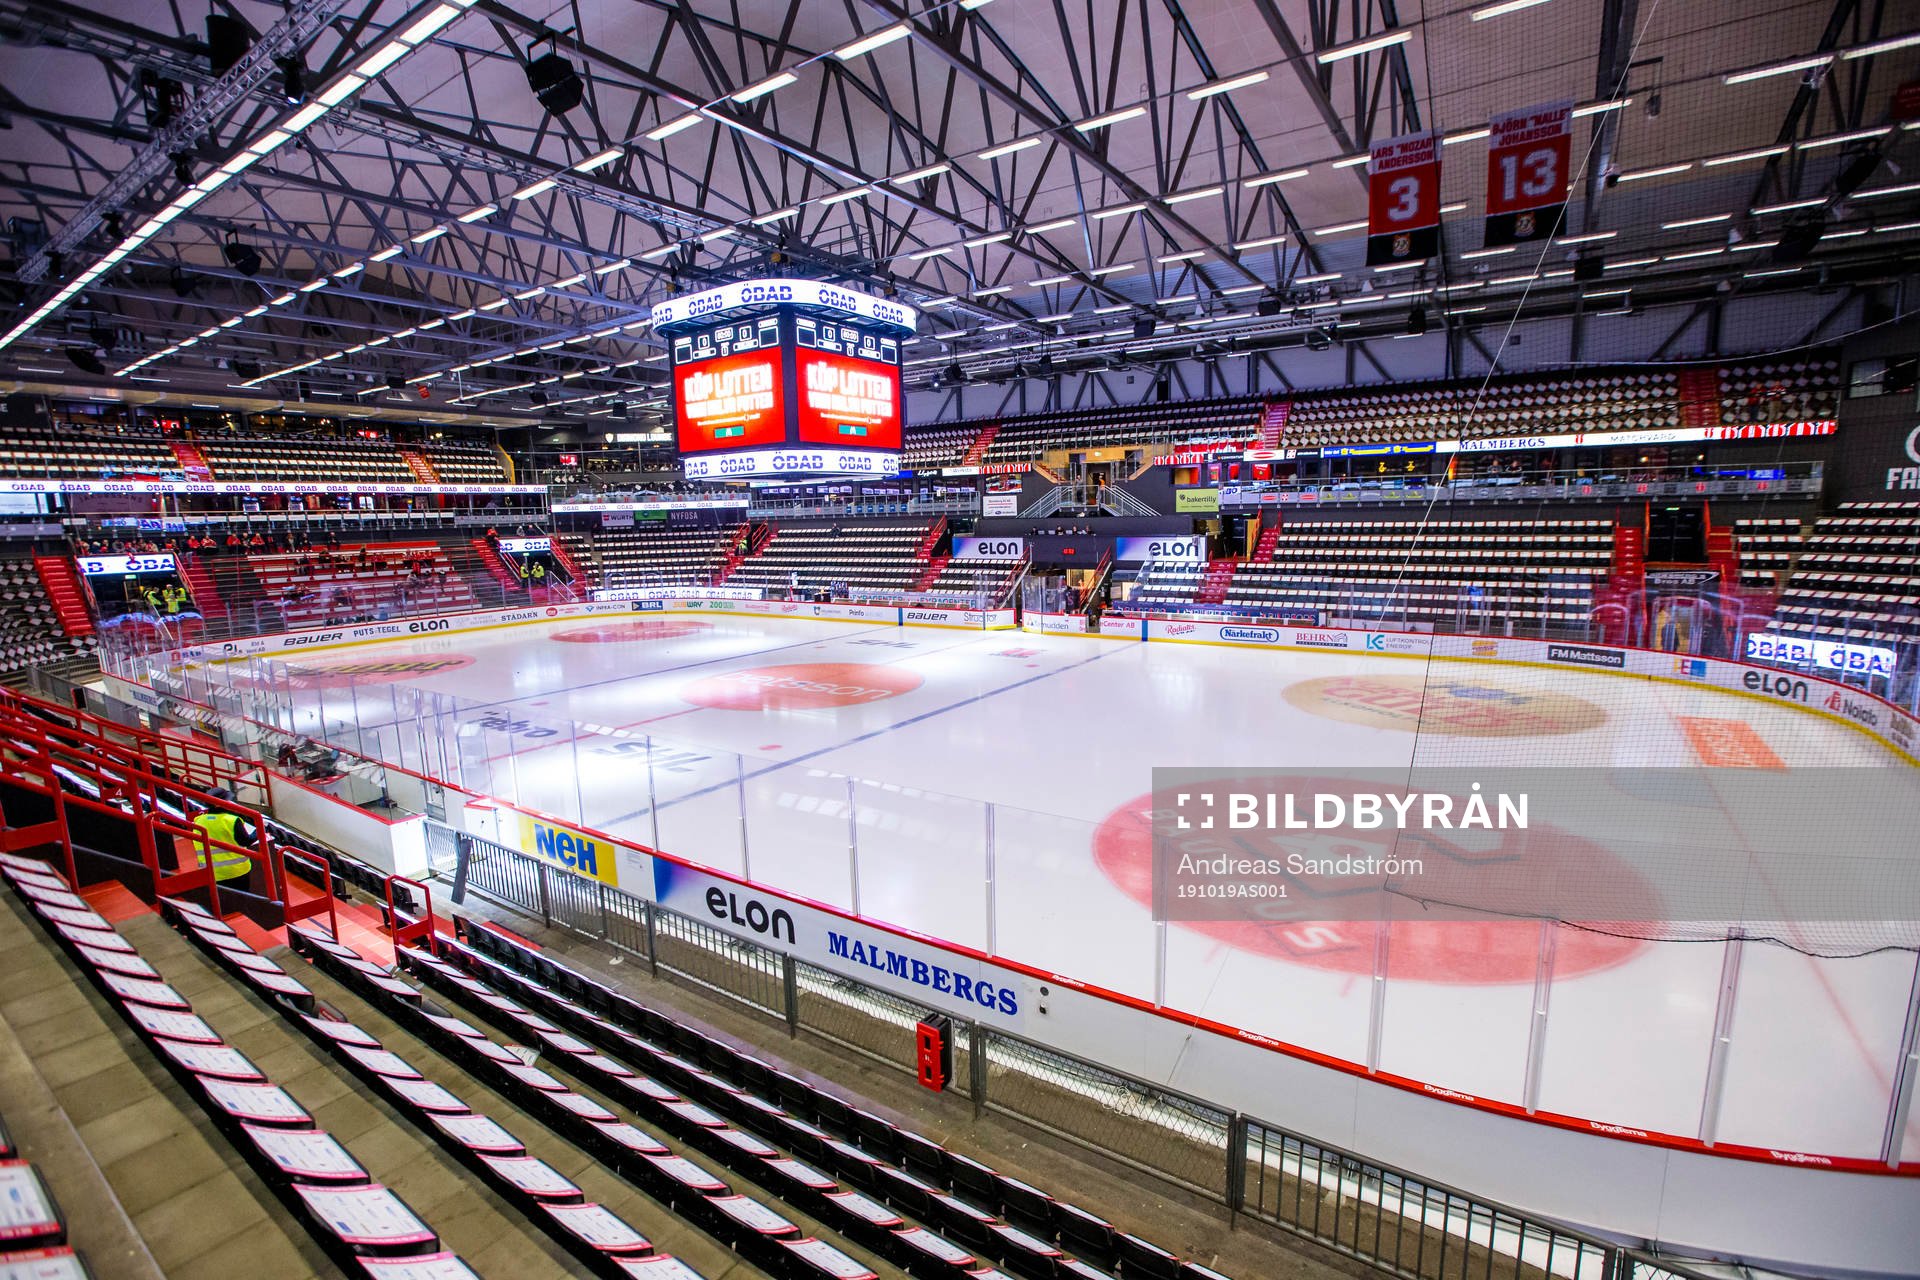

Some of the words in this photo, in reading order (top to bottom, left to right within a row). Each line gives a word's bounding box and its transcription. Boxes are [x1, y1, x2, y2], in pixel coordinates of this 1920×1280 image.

[1372, 145, 1394, 160] LARS
[1378, 150, 1434, 170] ANDERSSON
[1500, 149, 1558, 201] 13
[1387, 175, 1420, 222] 3
[714, 362, 773, 399] LOTTEN
[840, 367, 893, 401] LOTTEN
[1459, 437, 1546, 451] MALMBERGS
[1187, 495, 1217, 504] bakertilly
[671, 511, 698, 520] NYFOSA
[642, 601, 662, 609] BRL
[353, 627, 374, 638] PUTS
[377, 624, 402, 634] TEGEL
[1126, 621, 1135, 629] AB
[1296, 632, 1334, 643] BEHRN
[1551, 648, 1569, 659] FM
[1570, 650, 1622, 665] Mattsson
[828, 931, 1018, 1016] MALMBERGS
